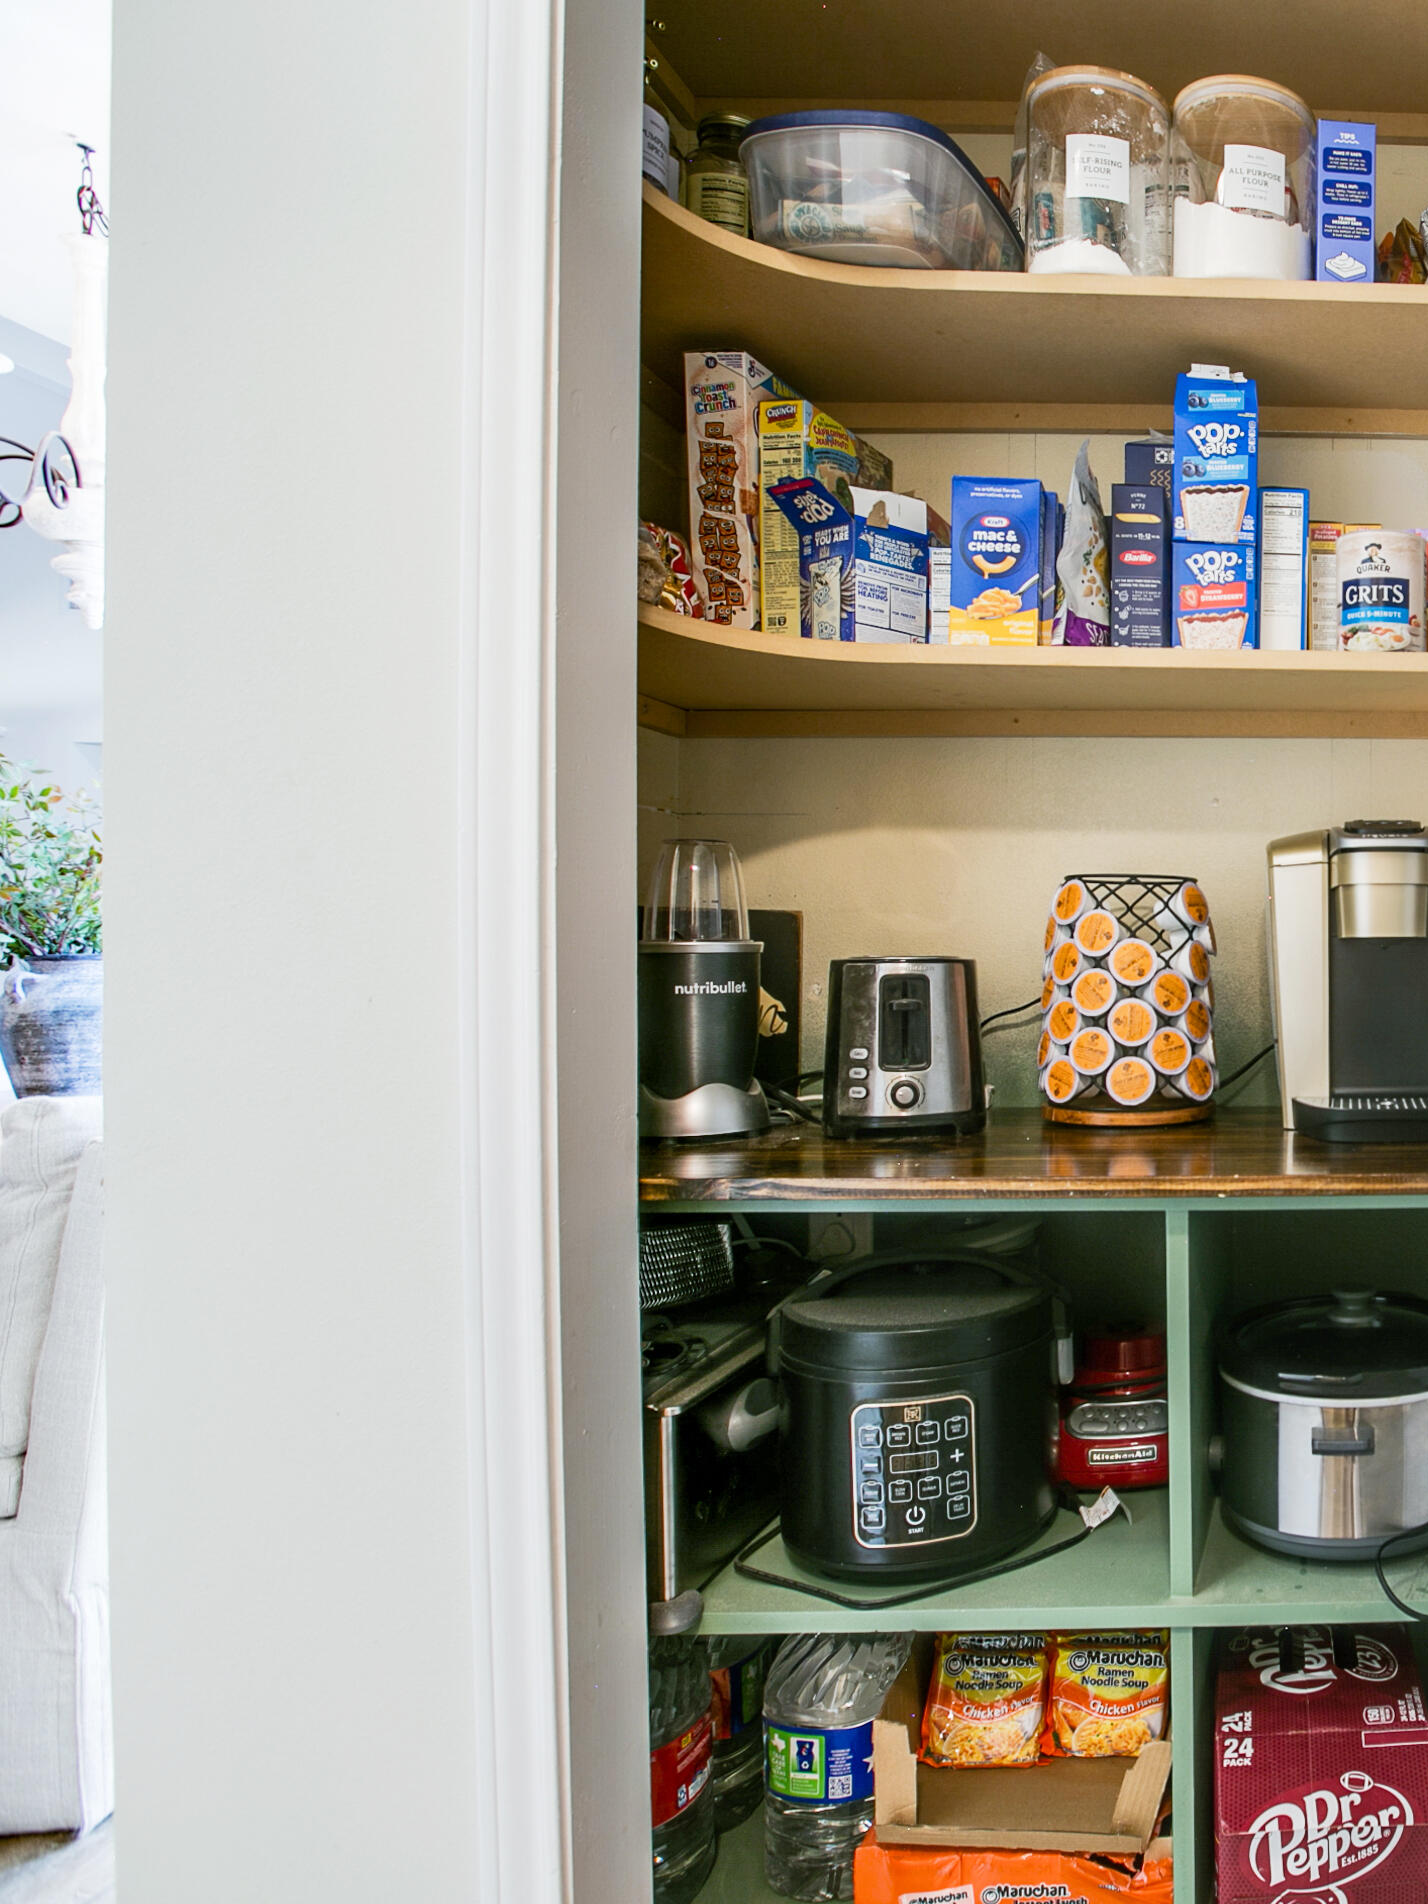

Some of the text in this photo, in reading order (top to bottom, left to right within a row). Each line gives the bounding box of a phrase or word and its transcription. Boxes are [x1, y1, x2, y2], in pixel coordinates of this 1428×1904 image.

[1083, 165, 1112, 175] FLOUR
[1246, 168, 1281, 183] PURPOSE
[1242, 177, 1269, 188] FLOUR
[691, 382, 735, 396] Cinnamon
[700, 390, 729, 403] Toast
[695, 397, 737, 415] Crunch
[766, 405, 797, 419] CRUNCH
[1198, 442, 1238, 459] tarts
[815, 531, 849, 546] YOU ARE
[972, 529, 1018, 542] mac &
[1123, 553, 1153, 563] Barilla
[1356, 563, 1391, 575] QUAKER
[1196, 569, 1236, 586] tarts
[857, 590, 889, 602] HEATING
[1345, 584, 1404, 605] GRITS
[674, 981, 746, 995] nutribullet
[1092, 1450, 1153, 1461] KitchenAid
[1087, 1650, 1165, 1668] Maruchan
[972, 1670, 1009, 1680] Ramen
[1097, 1666, 1135, 1678] Ramen
[995, 1680, 1024, 1691] Soup
[1081, 1676, 1149, 1690] Noodle Soup
[962, 1703, 1008, 1719] Chicken
[1089, 1696, 1161, 1715] Chicken Flavor
[1221, 1711, 1244, 1734] 24
[1244, 1710, 1252, 1732] PACK
[1222, 1737, 1255, 1759] 24
[1222, 1758, 1252, 1768] PACK
[1303, 1789, 1362, 1843] Dr
[1249, 1802, 1401, 1888] Pepper
[998, 1884, 1067, 1898] Maruchan
